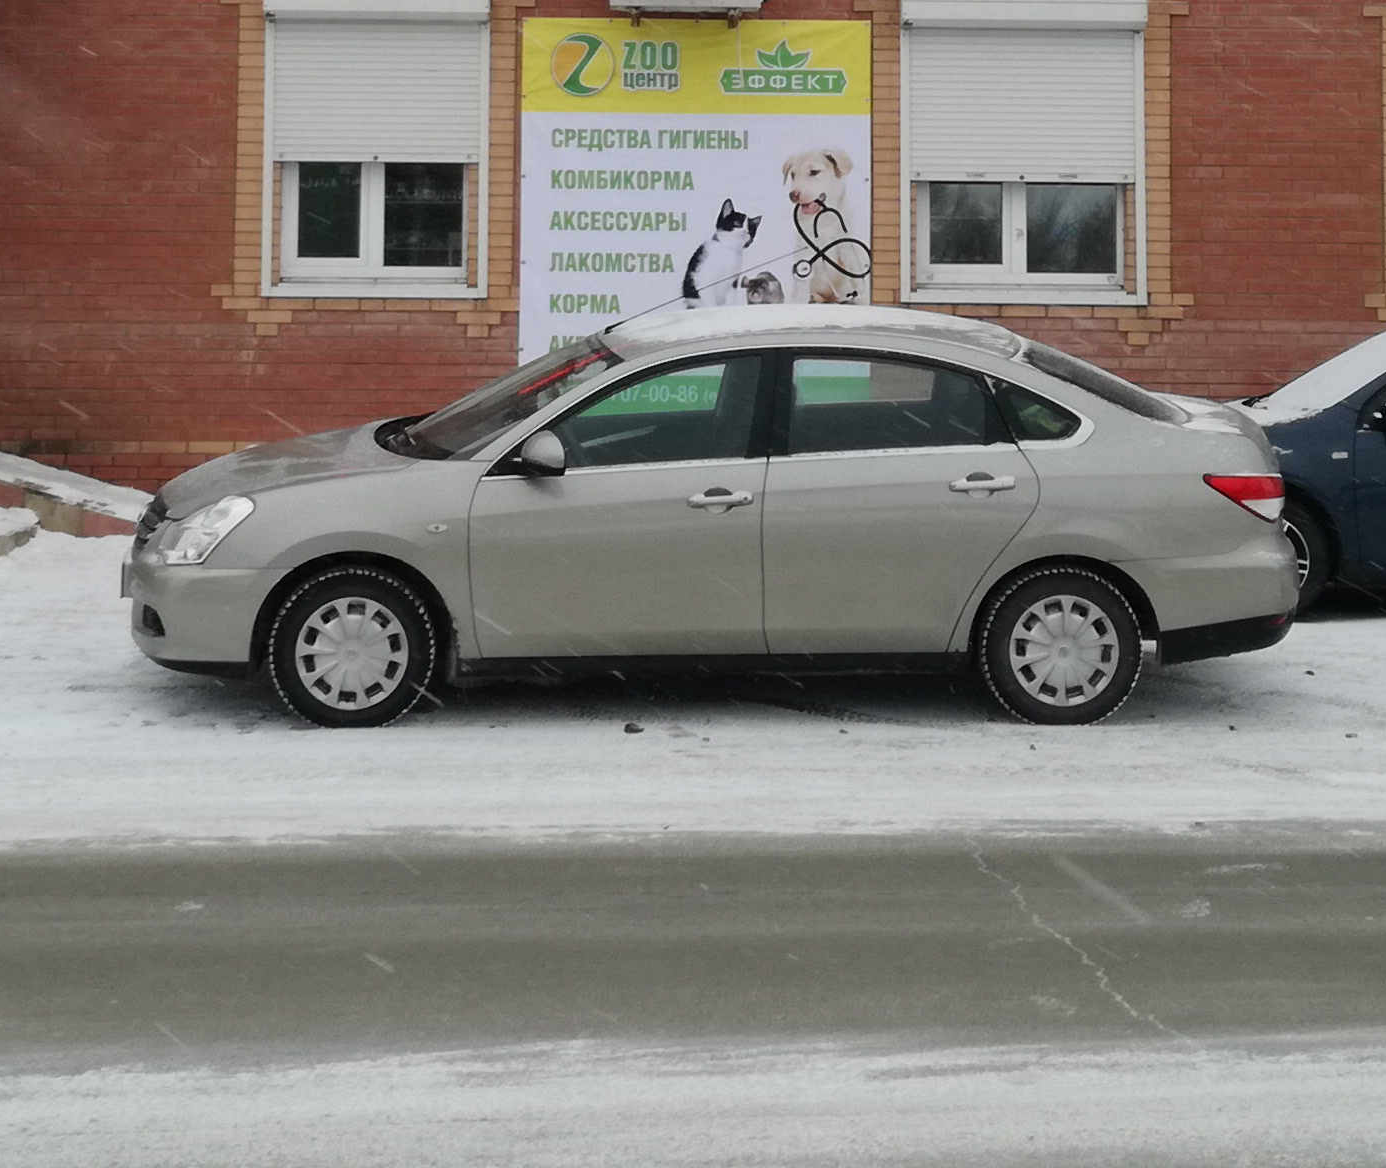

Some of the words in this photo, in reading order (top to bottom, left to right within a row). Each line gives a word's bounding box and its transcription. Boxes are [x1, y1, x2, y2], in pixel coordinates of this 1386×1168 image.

[623, 71, 680, 91] центр
[730, 73, 839, 91] ЭФФЕКТ
[551, 127, 652, 152] СРЕДСТВА
[657, 129, 749, 150] ГИГИЕНЫ
[550, 169, 695, 191] КОМБИКОРМА
[549, 210, 687, 233] АКСЕССУАРЫ
[548, 251, 675, 274] ЛАКОМСТВА
[548, 293, 622, 315] КОРМА
